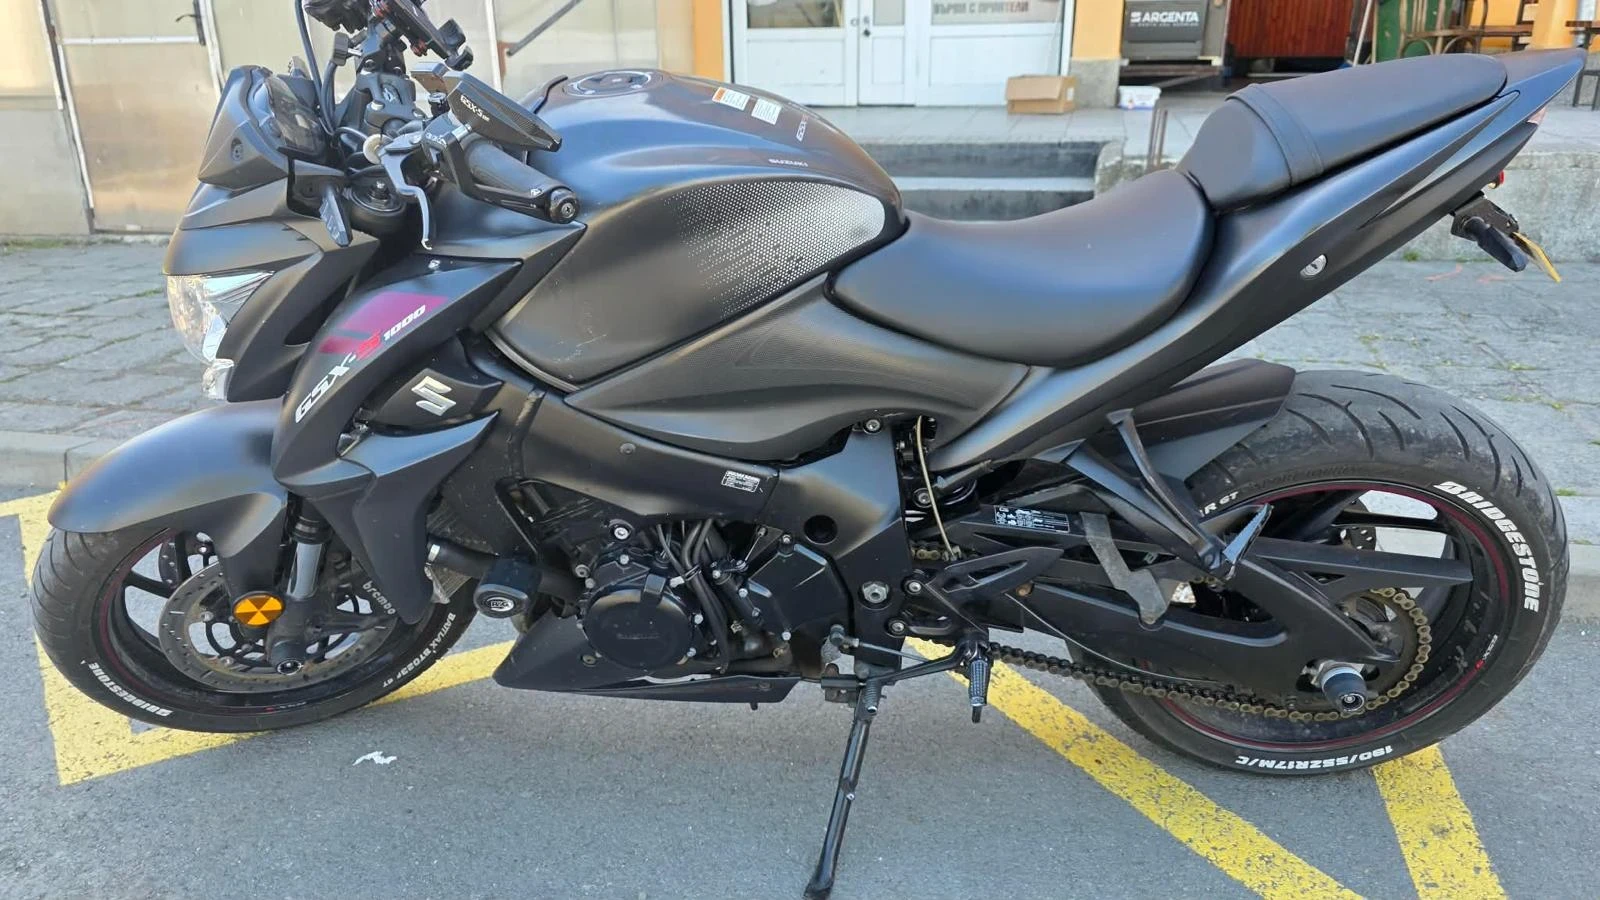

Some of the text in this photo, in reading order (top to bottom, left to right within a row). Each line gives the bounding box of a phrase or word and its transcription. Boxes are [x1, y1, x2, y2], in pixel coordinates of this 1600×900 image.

[1142, 11, 1200, 23] ARGENTA
[295, 304, 426, 423] GSX-S 1000
[1432, 480, 1544, 613] BRIDGESTONE
[362, 580, 397, 615] brembo
[429, 612, 457, 650] BATTLAX
[88, 661, 174, 718] BRIDGESTONE
